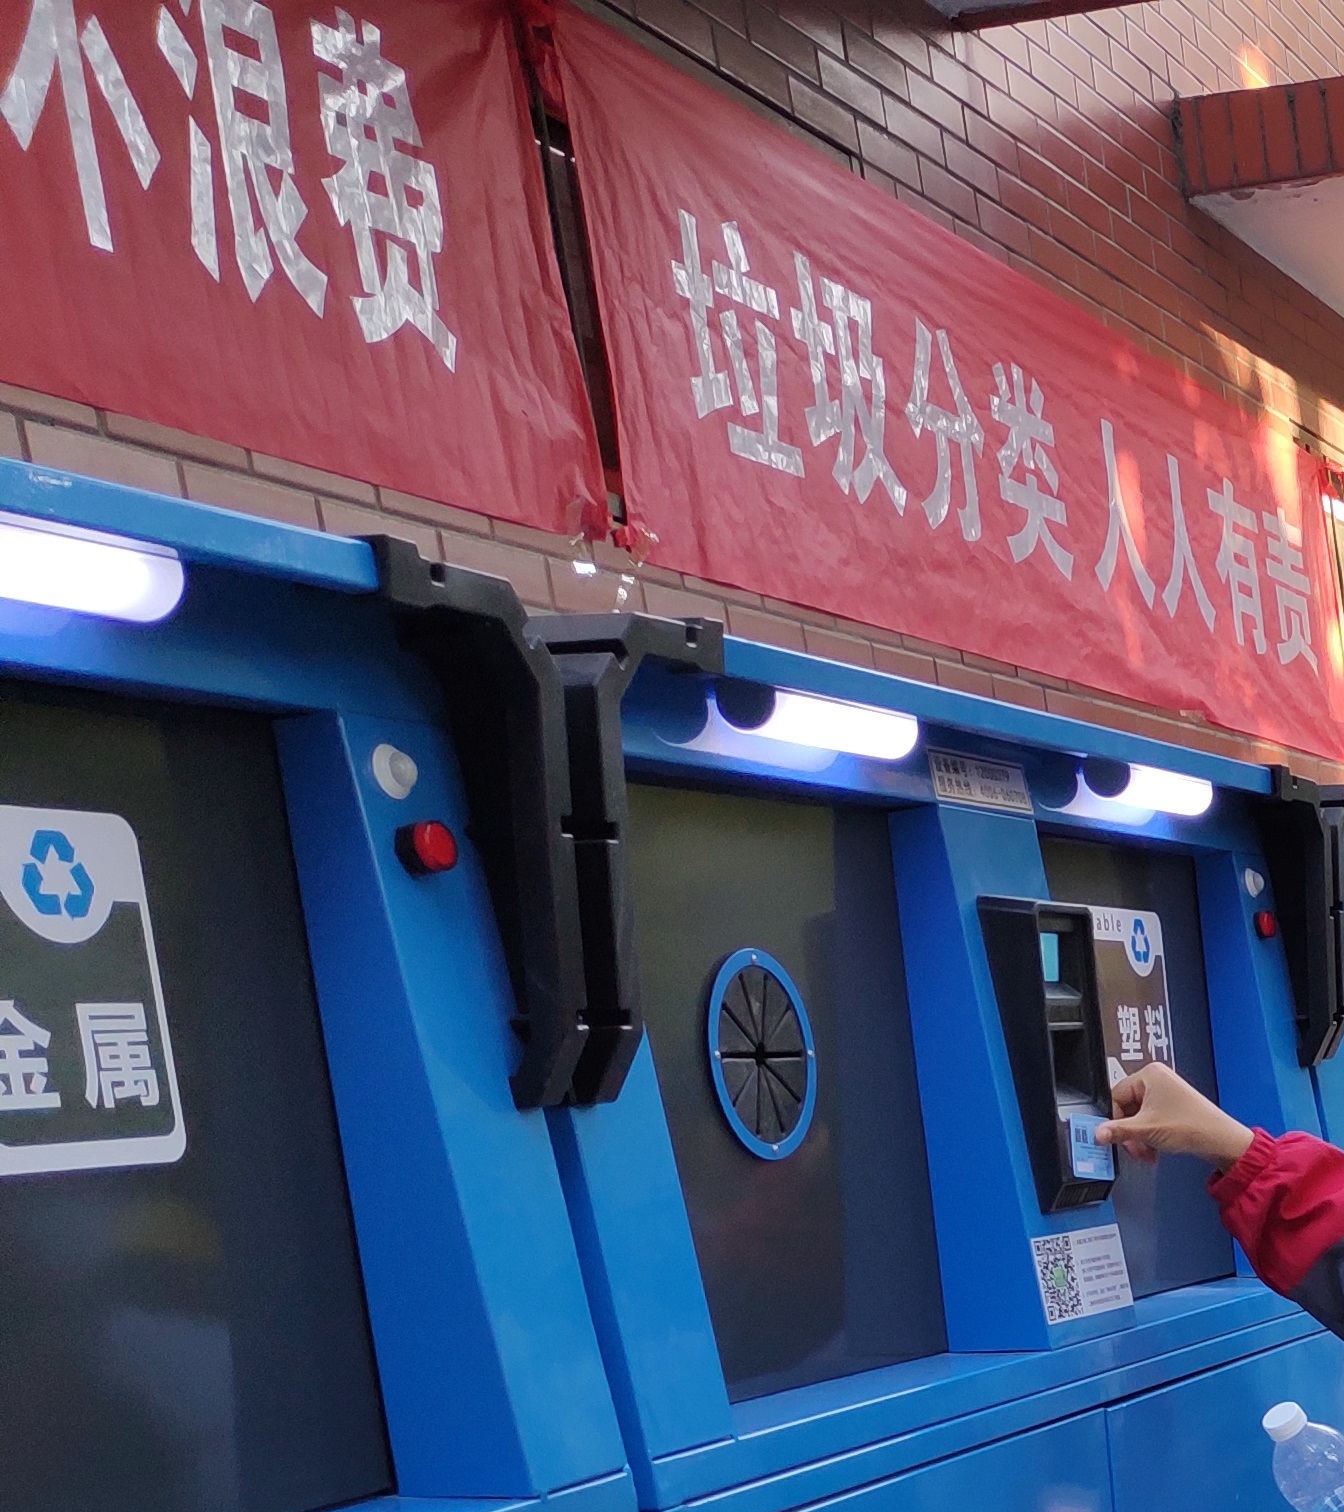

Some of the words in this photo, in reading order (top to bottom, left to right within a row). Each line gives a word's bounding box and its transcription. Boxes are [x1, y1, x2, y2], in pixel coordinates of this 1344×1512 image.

[0, 0, 457, 374] 不浪费
[671, 209, 1073, 581] 垃圾分类
[1095, 418, 1319, 673] 人人有责
[1117, 1004, 1169, 1062] 塑料
